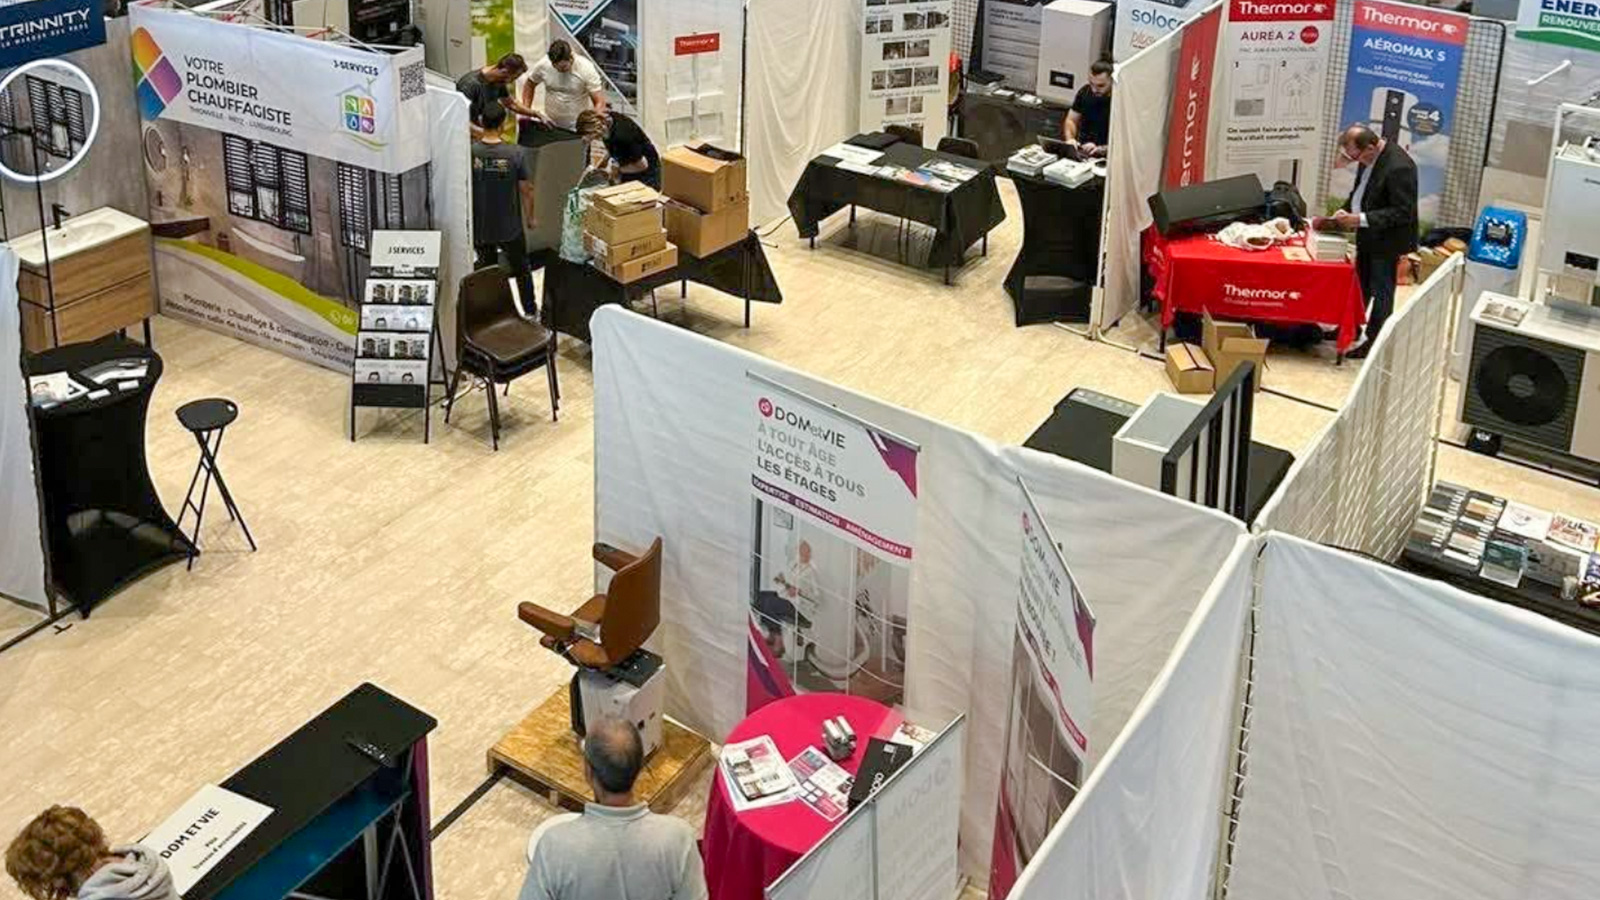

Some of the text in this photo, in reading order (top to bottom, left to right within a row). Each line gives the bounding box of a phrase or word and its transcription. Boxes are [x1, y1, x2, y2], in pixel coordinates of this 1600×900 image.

[1239, 1, 1311, 14] Thermor
[1362, 6, 1440, 32] Thermor
[1541, 0, 1600, 17] ENER
[0, 8, 90, 40] TRINNITY
[1241, 30, 1284, 41] AURÉA
[1288, 31, 1295, 40] 2
[1363, 38, 1434, 60] AÉROMAX
[1437, 50, 1446, 61] S
[184, 55, 224, 75] VOTRE
[187, 72, 258, 100] PLOMBIER
[188, 89, 292, 126] CHAUFFAGISTE
[1429, 110, 1440, 122] 4
[393, 246, 425, 255] SERVICES
[1224, 284, 1288, 299] Thermor
[227, 308, 268, 330] Chauffage
[769, 427, 806, 450] TOUT
[808, 441, 837, 467] ÂGE
[757, 439, 812, 472] L'ACCÈS
[826, 469, 867, 498] TOUS
[757, 456, 838, 502] LES ÉTAGES
[795, 496, 840, 526] ESTIMATION
[845, 521, 908, 556] AMÉNAGEMENT
[160, 808, 220, 859] DOM ET VIE
